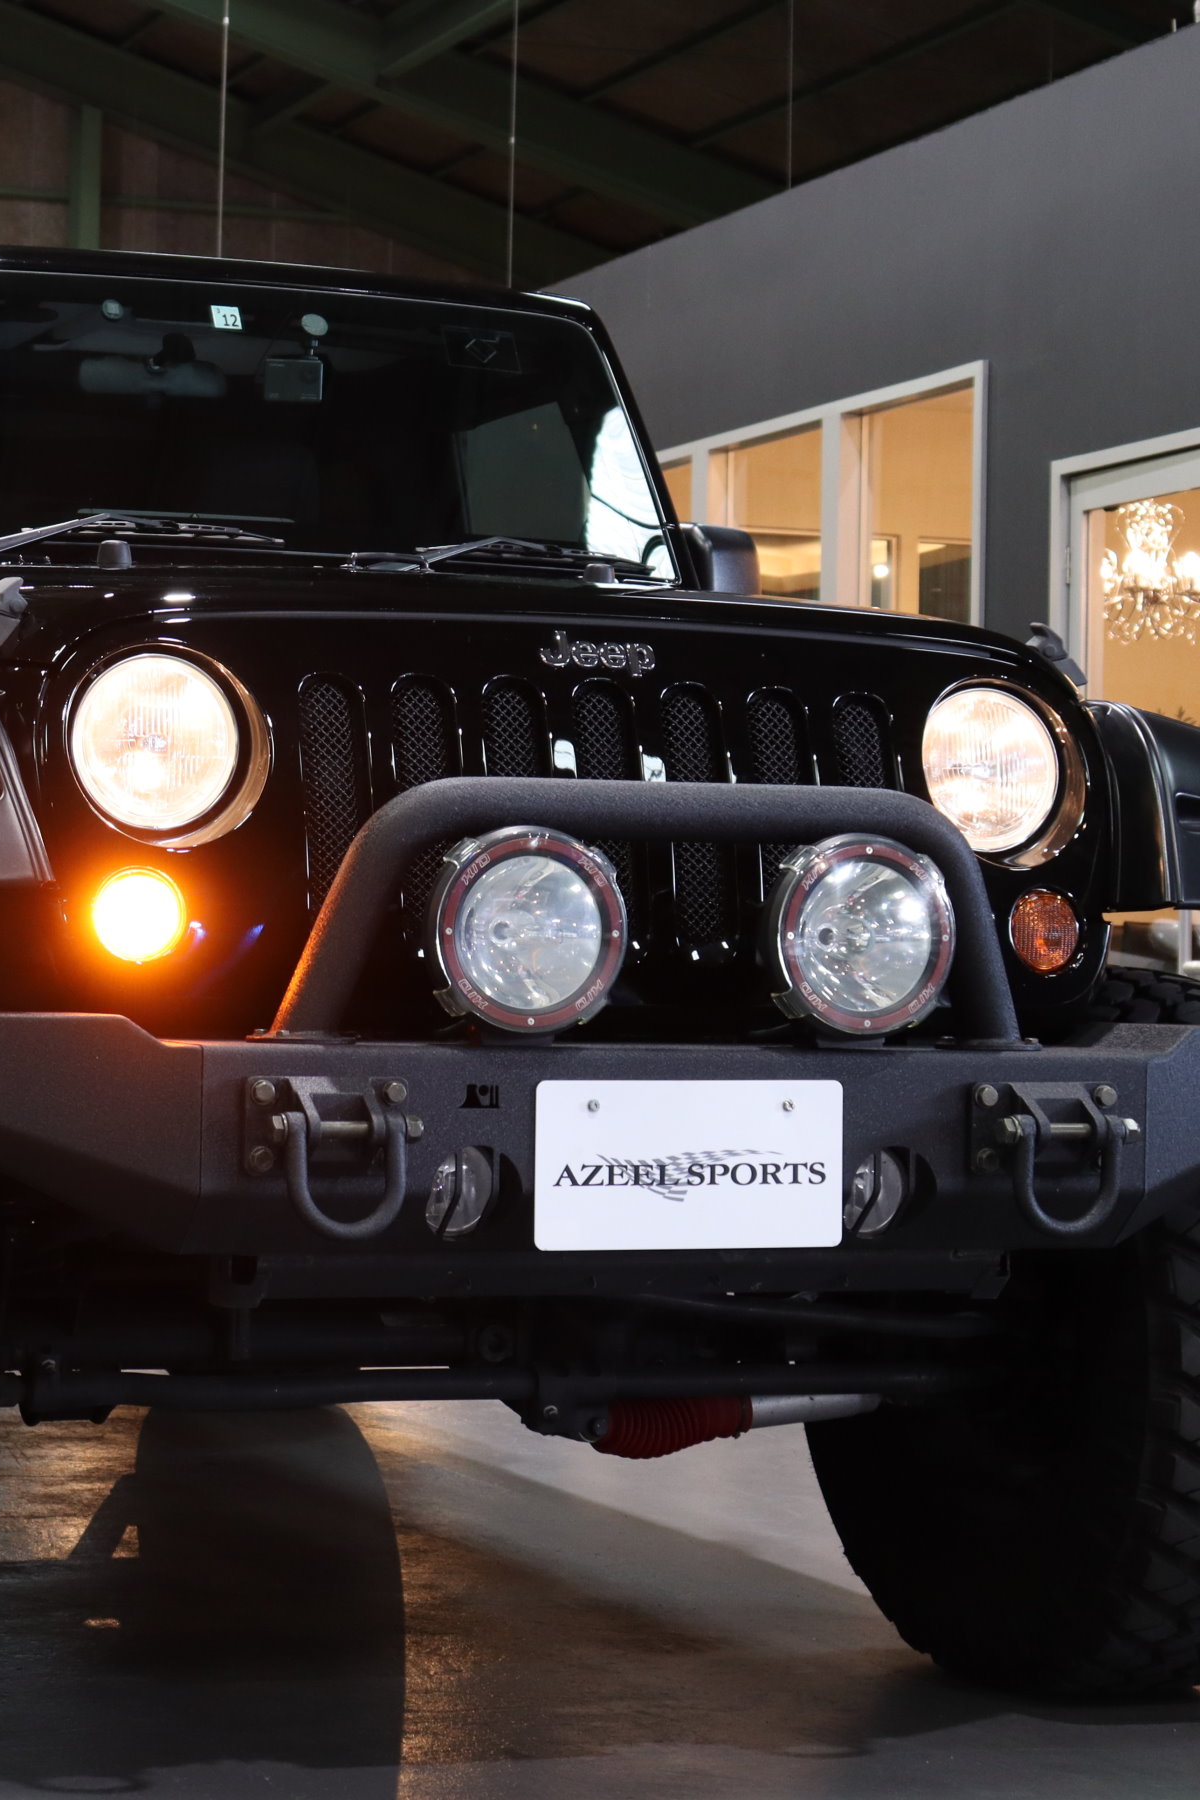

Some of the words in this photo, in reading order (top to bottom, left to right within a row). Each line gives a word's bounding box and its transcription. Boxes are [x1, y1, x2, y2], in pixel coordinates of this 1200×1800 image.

[222, 313, 239, 327] 12
[540, 630, 656, 677] Jeep
[553, 1164, 681, 1187] AZEEL
[686, 1161, 827, 1186] SPORTS
